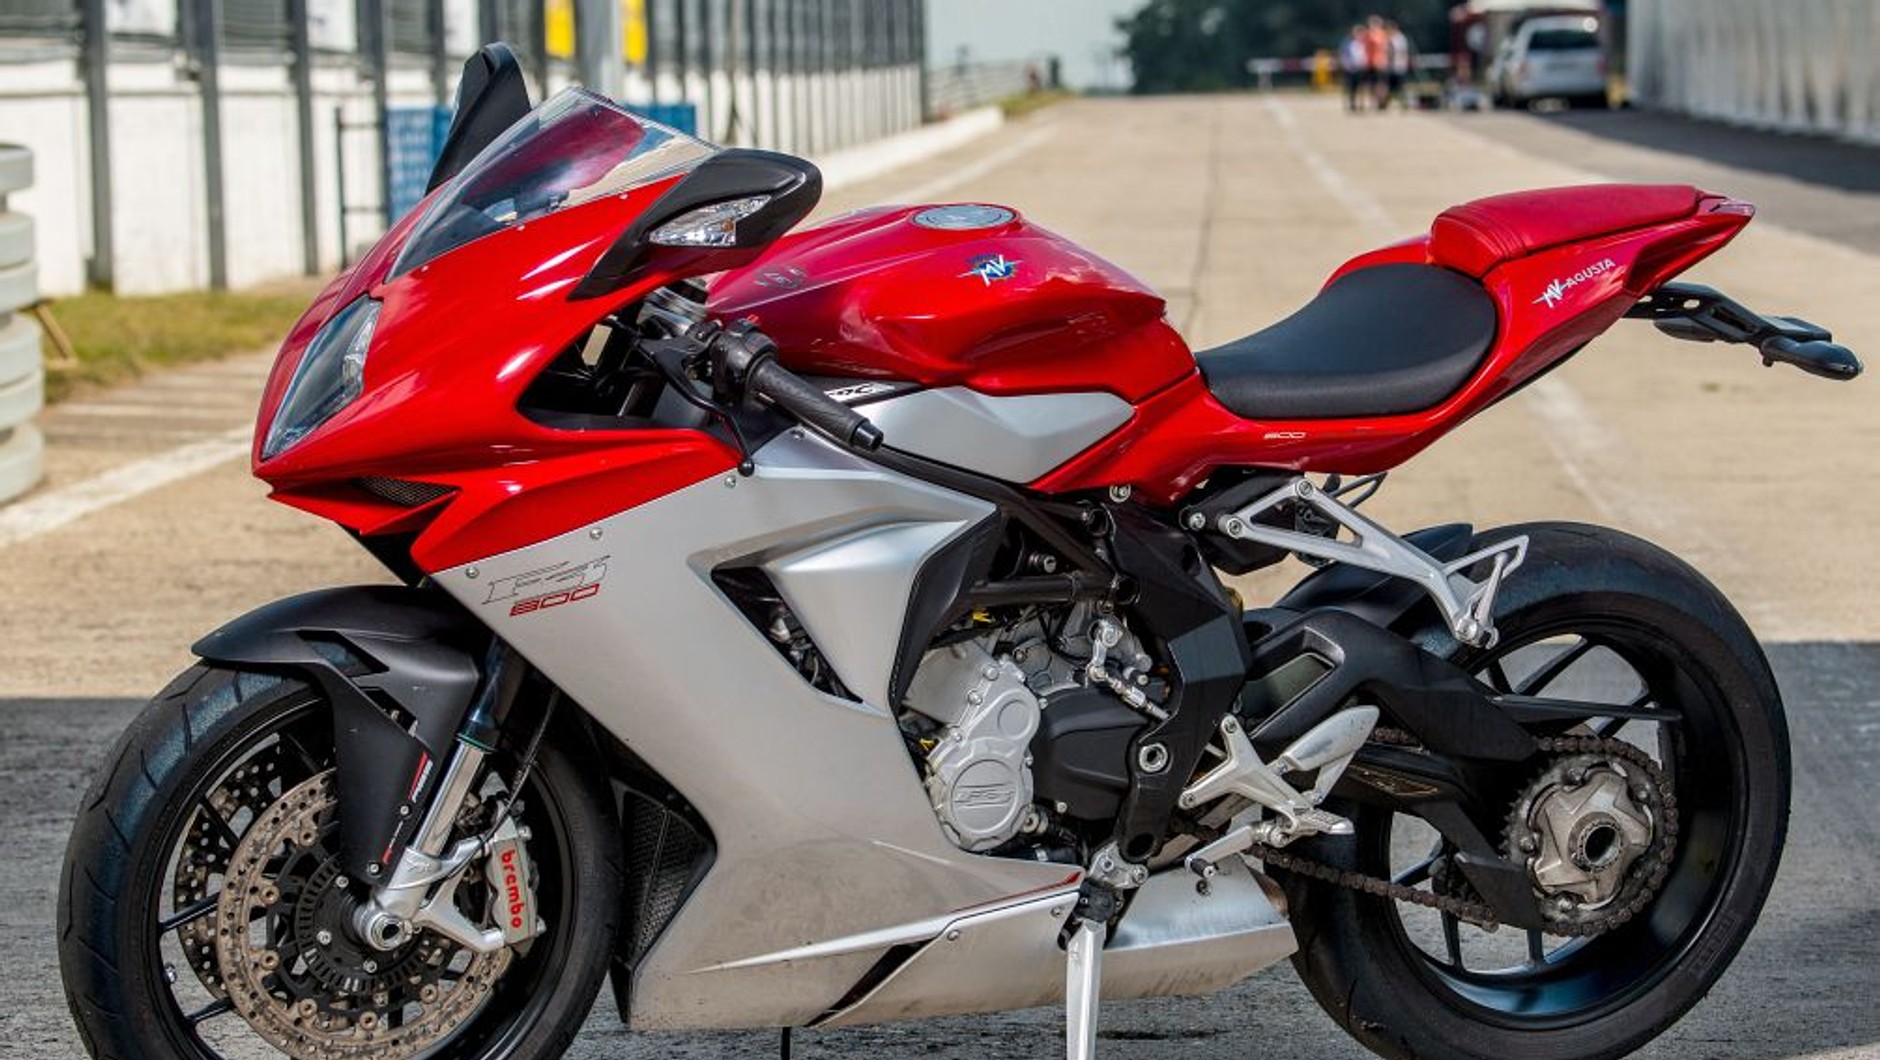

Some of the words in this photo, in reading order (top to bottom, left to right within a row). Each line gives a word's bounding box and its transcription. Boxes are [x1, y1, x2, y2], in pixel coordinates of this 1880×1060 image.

[1565, 258, 1616, 288] AGUSTA
[509, 583, 600, 617] 800
[501, 849, 525, 929] brembo
